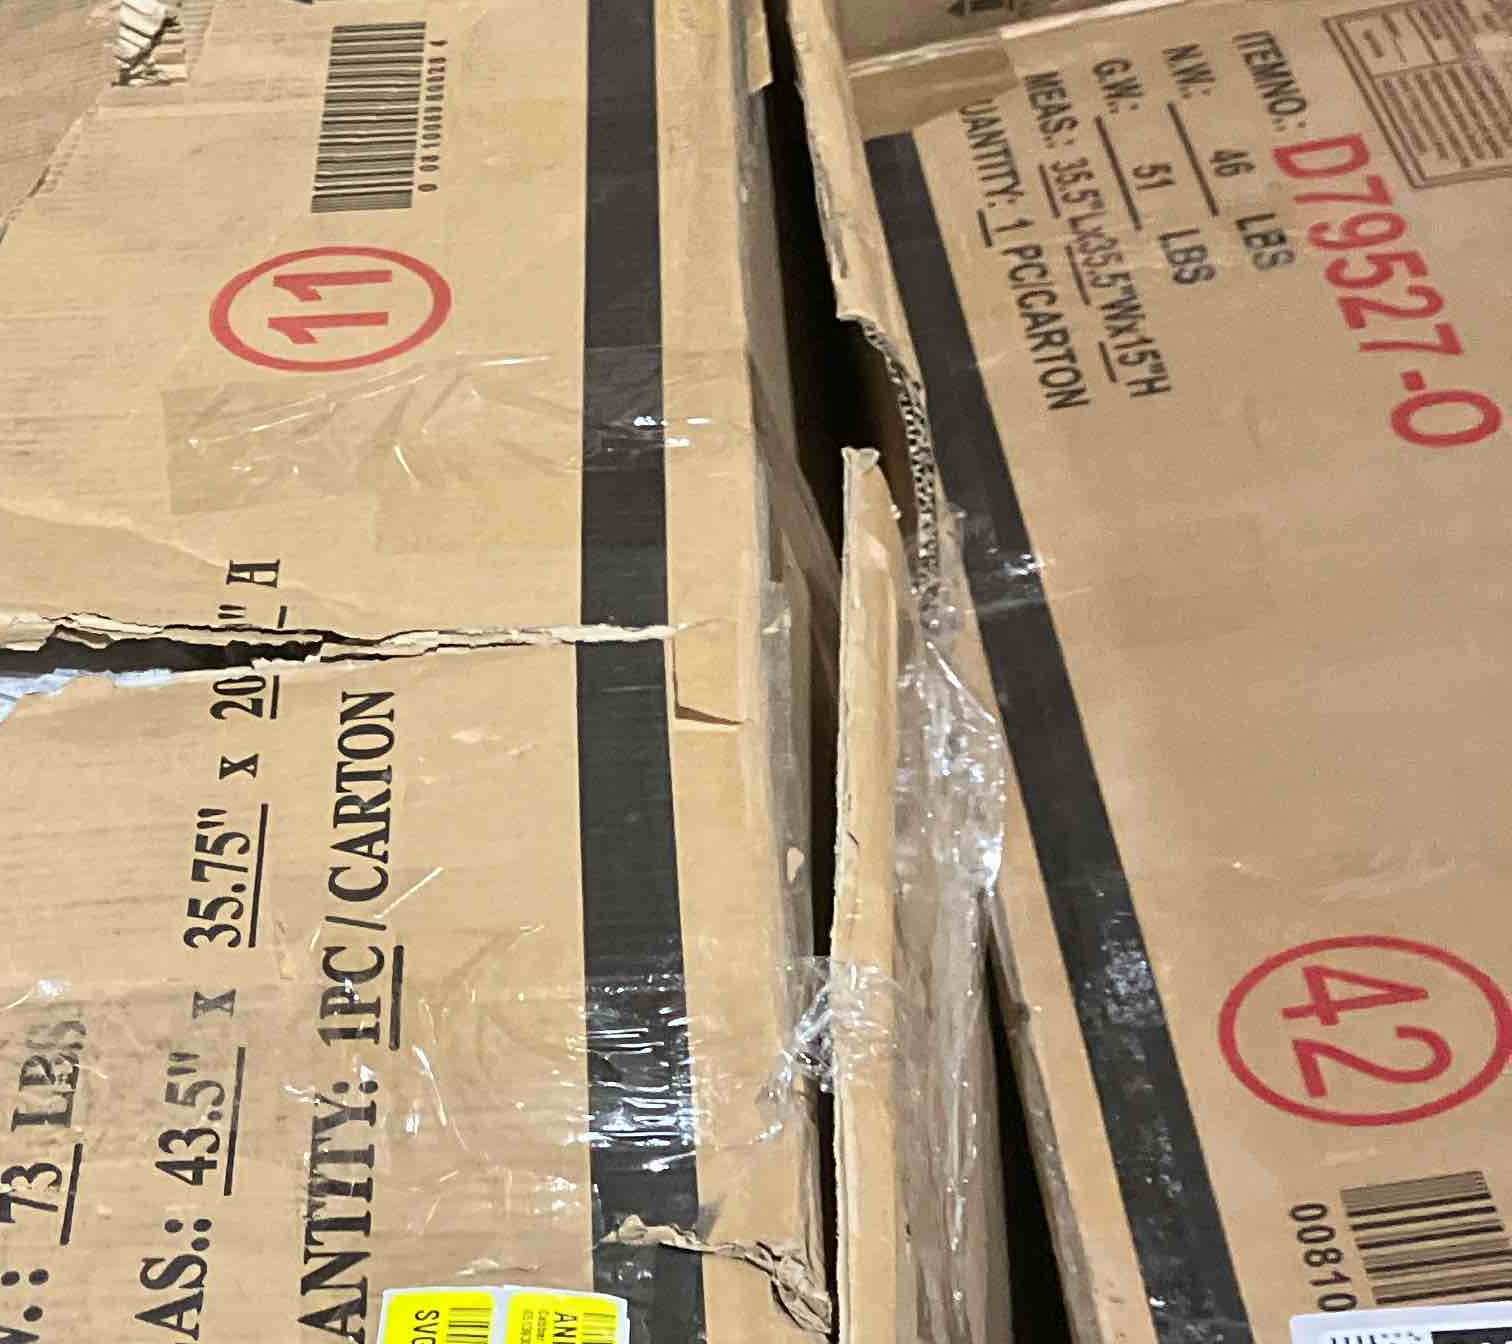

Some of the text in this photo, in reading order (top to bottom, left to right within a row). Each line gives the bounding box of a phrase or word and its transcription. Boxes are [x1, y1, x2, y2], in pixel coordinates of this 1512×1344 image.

[1132, 162, 1176, 191] 51
[1159, 228, 1216, 286] LBS
[1234, 212, 1295, 271] LBS
[267, 269, 393, 345] 11
[183, 806, 251, 949] 35.75"
[1281, 965, 1452, 1098] 42
[154, 1052, 226, 1187] 43.5"
